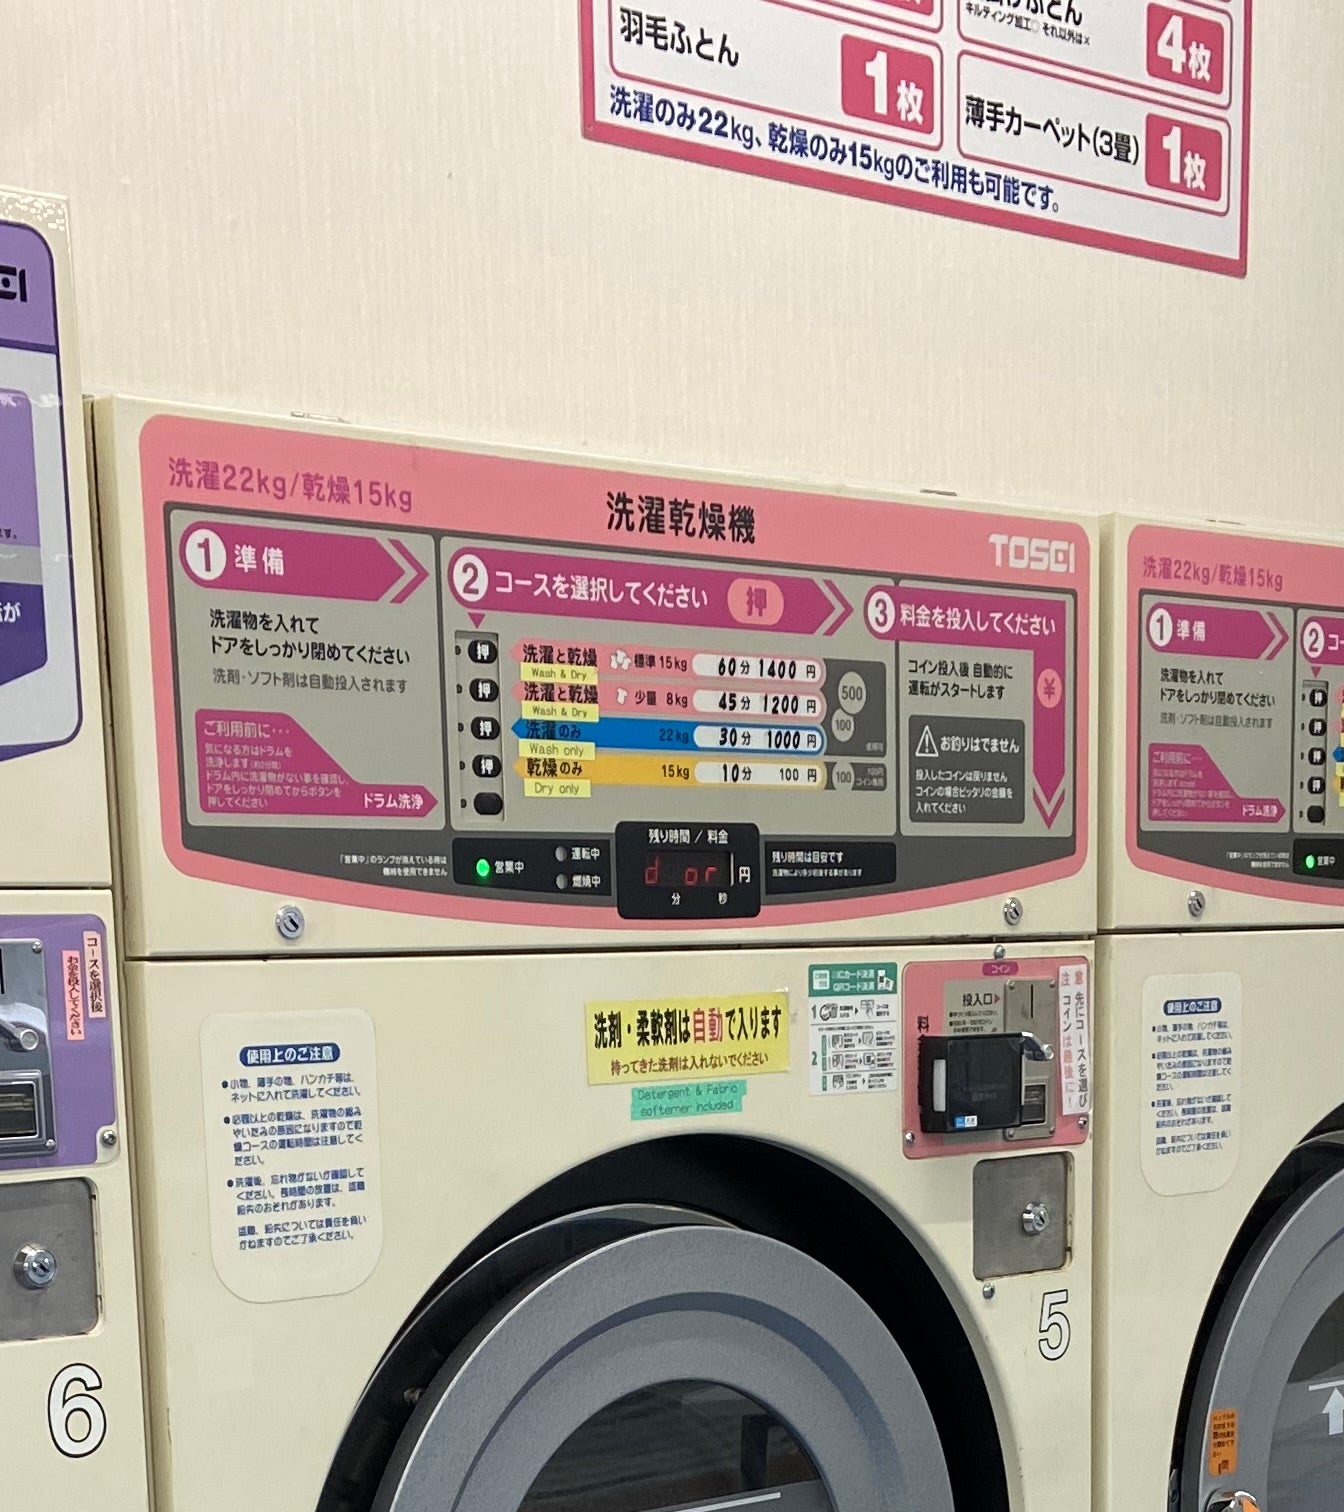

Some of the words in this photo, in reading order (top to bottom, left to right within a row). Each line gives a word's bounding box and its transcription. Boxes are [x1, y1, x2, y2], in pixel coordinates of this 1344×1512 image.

[620, 6, 740, 67] 羽毛ふとん
[1157, 16, 1211, 82] 4枚
[865, 51, 926, 125] 1枚
[965, 94, 1140, 165] 薄手カーペット(3畳)
[609, 84, 1059, 214] 洗濯のみ22kg、乾燥のみ15kgのご利用も可能です。
[1162, 125, 1206, 192] 1枚
[168, 456, 413, 513] 洗濯22kg/乾燥15kg
[607, 491, 756, 544] 洗濯乾燥機
[233, 543, 285, 577] 準備
[988, 533, 1075, 573] TOSEI
[494, 567, 709, 609] コースを選択してください
[209, 607, 320, 635] 洗濯物を入れて
[900, 604, 1056, 636] 料金を投入してください
[210, 635, 411, 666] ドアをしっかり閉めてください
[522, 643, 598, 667] 洗濯と乾燥
[634, 654, 656, 669] 標準
[659, 656, 687, 672] 15kg
[758, 659, 797, 679] 1400
[212, 667, 408, 694] 洗剤・ソフト剤は自動投入されます
[908, 659, 971, 679] コイン投入後
[973, 662, 1014, 680] 自動的に
[1160, 667, 1224, 686] 洗濯物を入れて
[523, 682, 598, 704] 洗濯と乾燥
[634, 690, 656, 706] 少量
[763, 693, 799, 714] 1200
[841, 684, 863, 701] 500
[908, 680, 1005, 700] 運転がスタートします
[1159, 688, 1275, 708] ドアをしっかり閉めてください
[526, 723, 581, 740] 洗濯のみ
[659, 728, 689, 744] 22kg
[767, 730, 801, 749] 1000
[835, 719, 852, 732] 100
[940, 736, 1020, 754] お釣りはでません
[526, 759, 583, 777] 乾燥のみ
[661, 764, 689, 779] 15kg
[779, 768, 799, 781] 100
[364, 793, 424, 810] ドラム洗浄
[916, 802, 966, 815] 入れてください
[648, 829, 690, 844] 残り時間
[494, 859, 524, 875] 営業中
[572, 847, 600, 860] 運転中
[771, 851, 844, 864] 残り時間は目安です
[87, 936, 103, 1013] コースを選択後
[990, 965, 1011, 974] コイン
[66, 955, 82, 1036] お金を投入してください
[962, 993, 993, 1006] 投入口
[593, 1006, 783, 1050] 洗剤・柔軟剤は自動で入ります
[247, 1046, 334, 1064] 使用上のご注意
[610, 1051, 769, 1076] 持ってきた洗剤は入れないでください
[1037, 1290, 1071, 1361] 5
[46, 1361, 107, 1458] 6
